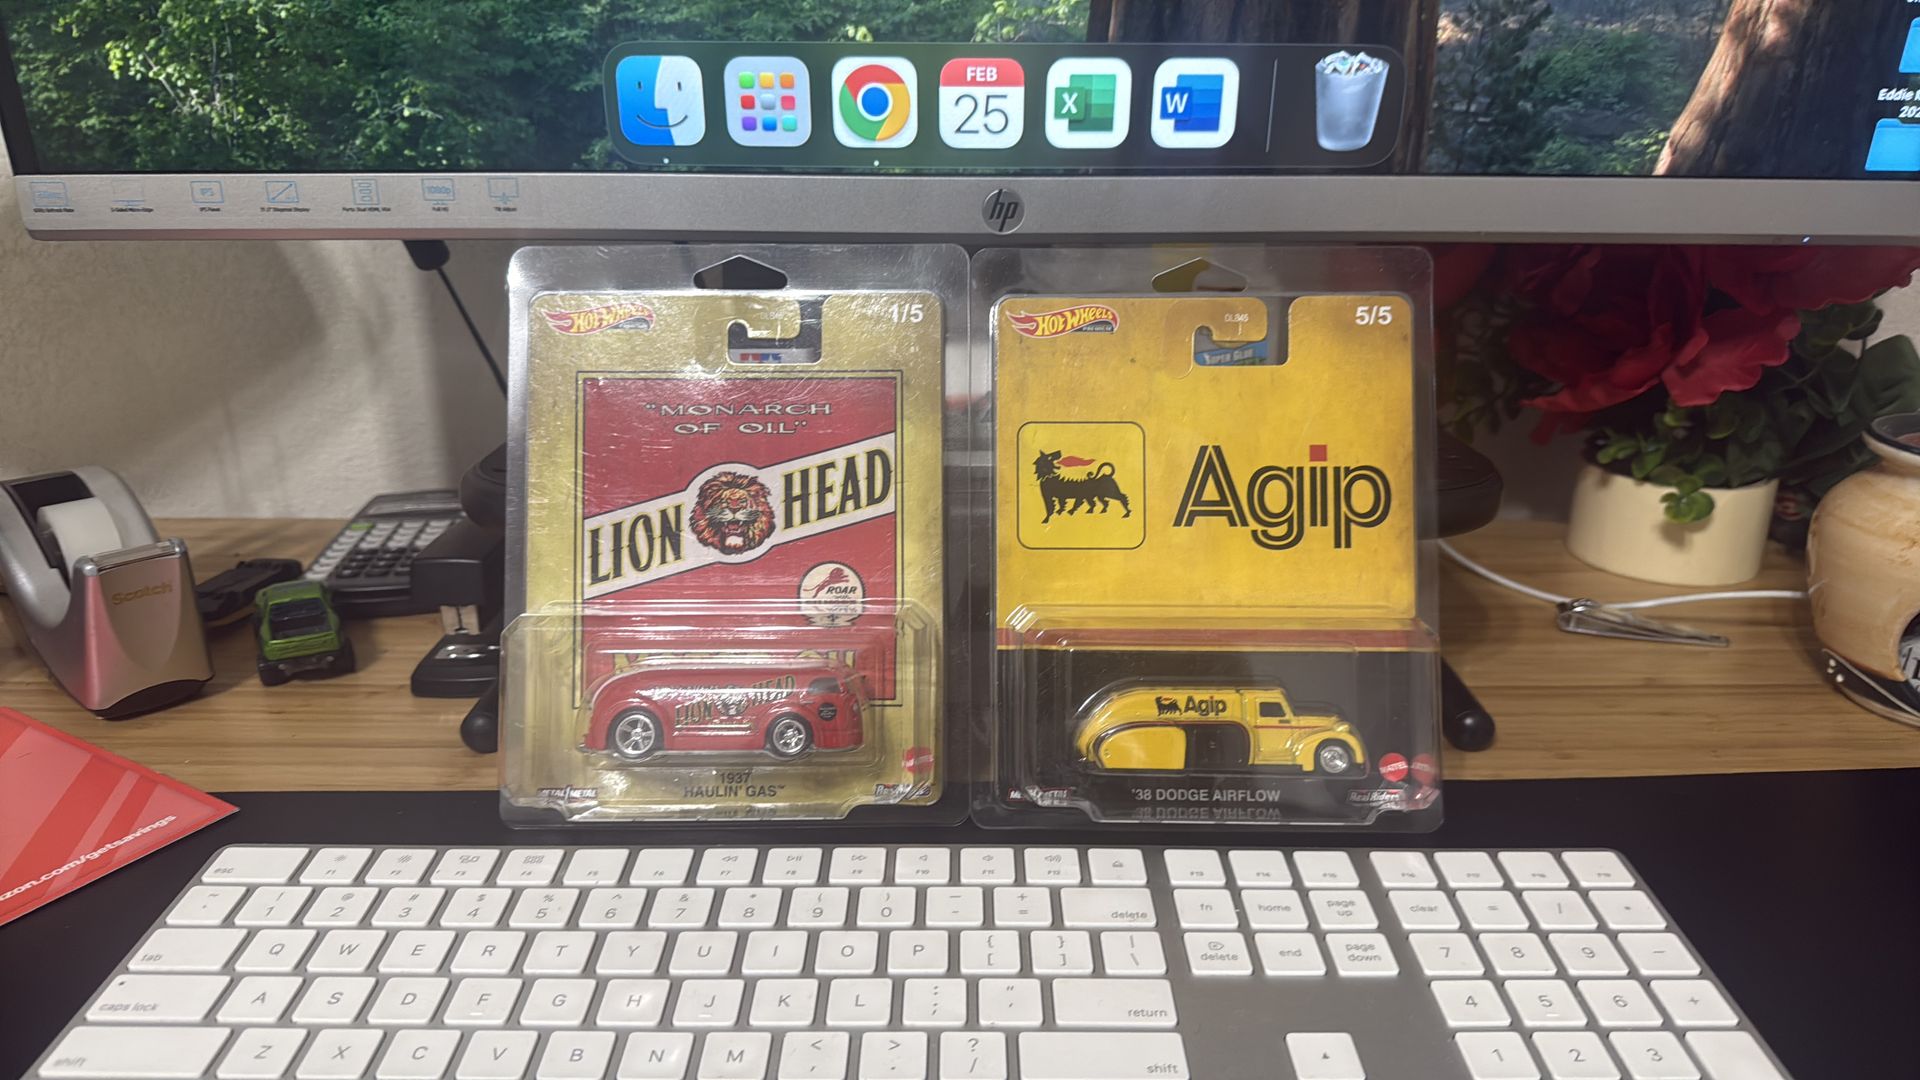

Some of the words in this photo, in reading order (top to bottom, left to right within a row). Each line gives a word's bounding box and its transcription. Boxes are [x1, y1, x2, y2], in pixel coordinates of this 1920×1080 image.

[966, 66, 998, 81] FEB
[1877, 88, 1914, 101] Eddie
[1061, 92, 1078, 114] X
[1164, 92, 1188, 113] W
[954, 94, 1009, 134] 25
[988, 188, 1018, 232] hp
[889, 303, 924, 324] 1/5
[1355, 306, 1393, 325] 5/5
[673, 421, 720, 435] OF
[1172, 444, 1392, 549] Agip
[588, 503, 685, 586] LION
[780, 448, 894, 532] HEAD
[111, 582, 173, 605] Scotch
[825, 585, 858, 595] ROAR
[1183, 695, 1227, 717] Agip
[720, 772, 750, 784] 1937
[1155, 789, 1210, 801] DODGE
[1212, 789, 1281, 802] AIRFLOW
[1199, 903, 1214, 912] fn
[1257, 903, 1292, 913] home
[1325, 899, 1357, 909] page
[1408, 904, 1439, 913] clear
[264, 905, 276, 918] 1
[329, 906, 346, 918] 2
[397, 906, 413, 919] 3
[466, 906, 481, 919] 4
[535, 907, 549, 920] 5
[604, 907, 618, 920] 6
[674, 907, 688, 920] 7
[742, 906, 756, 919] 8
[811, 906, 824, 919] 9
[880, 906, 893, 918] 0
[1111, 910, 1149, 920] delete
[1335, 909, 1354, 918] up
[268, 942, 286, 957] Q
[338, 943, 361, 956] W
[410, 943, 427, 957] E
[480, 944, 497, 957] R
[555, 944, 569, 958] T
[627, 944, 641, 958] Y
[696, 945, 713, 958] U
[772, 944, 779, 958] I
[840, 944, 855, 958] O
[912, 944, 925, 957] P
[1278, 948, 1303, 958] end
[1344, 943, 1376, 953] page
[1439, 946, 1451, 959] 7
[1510, 946, 1526, 959] 8
[1580, 946, 1597, 959] 9
[1199, 952, 1239, 962] delete
[1346, 953, 1382, 963] down
[250, 991, 267, 1005] A
[326, 991, 345, 1006] S
[399, 992, 418, 1006] D
[476, 992, 492, 1006] F
[551, 993, 568, 1008] G
[625, 994, 642, 1007] H
[703, 994, 717, 1009] J
[777, 994, 792, 1008] K
[854, 993, 866, 1008] L
[1464, 995, 1479, 1008] 4
[1537, 994, 1554, 1008] 5
[1612, 994, 1629, 1008] 6
[1127, 1008, 1169, 1018] return
[253, 1044, 273, 1060] Z
[330, 1045, 352, 1060] X
[411, 1045, 429, 1061] C
[492, 1047, 509, 1062] V
[568, 1047, 585, 1063] B
[648, 1048, 666, 1063] N
[725, 1049, 745, 1064] M
[1491, 1048, 1505, 1063] 1
[1567, 1048, 1587, 1063] 2
[1645, 1047, 1664, 1063] 3
[1146, 1063, 1179, 1075] shift
